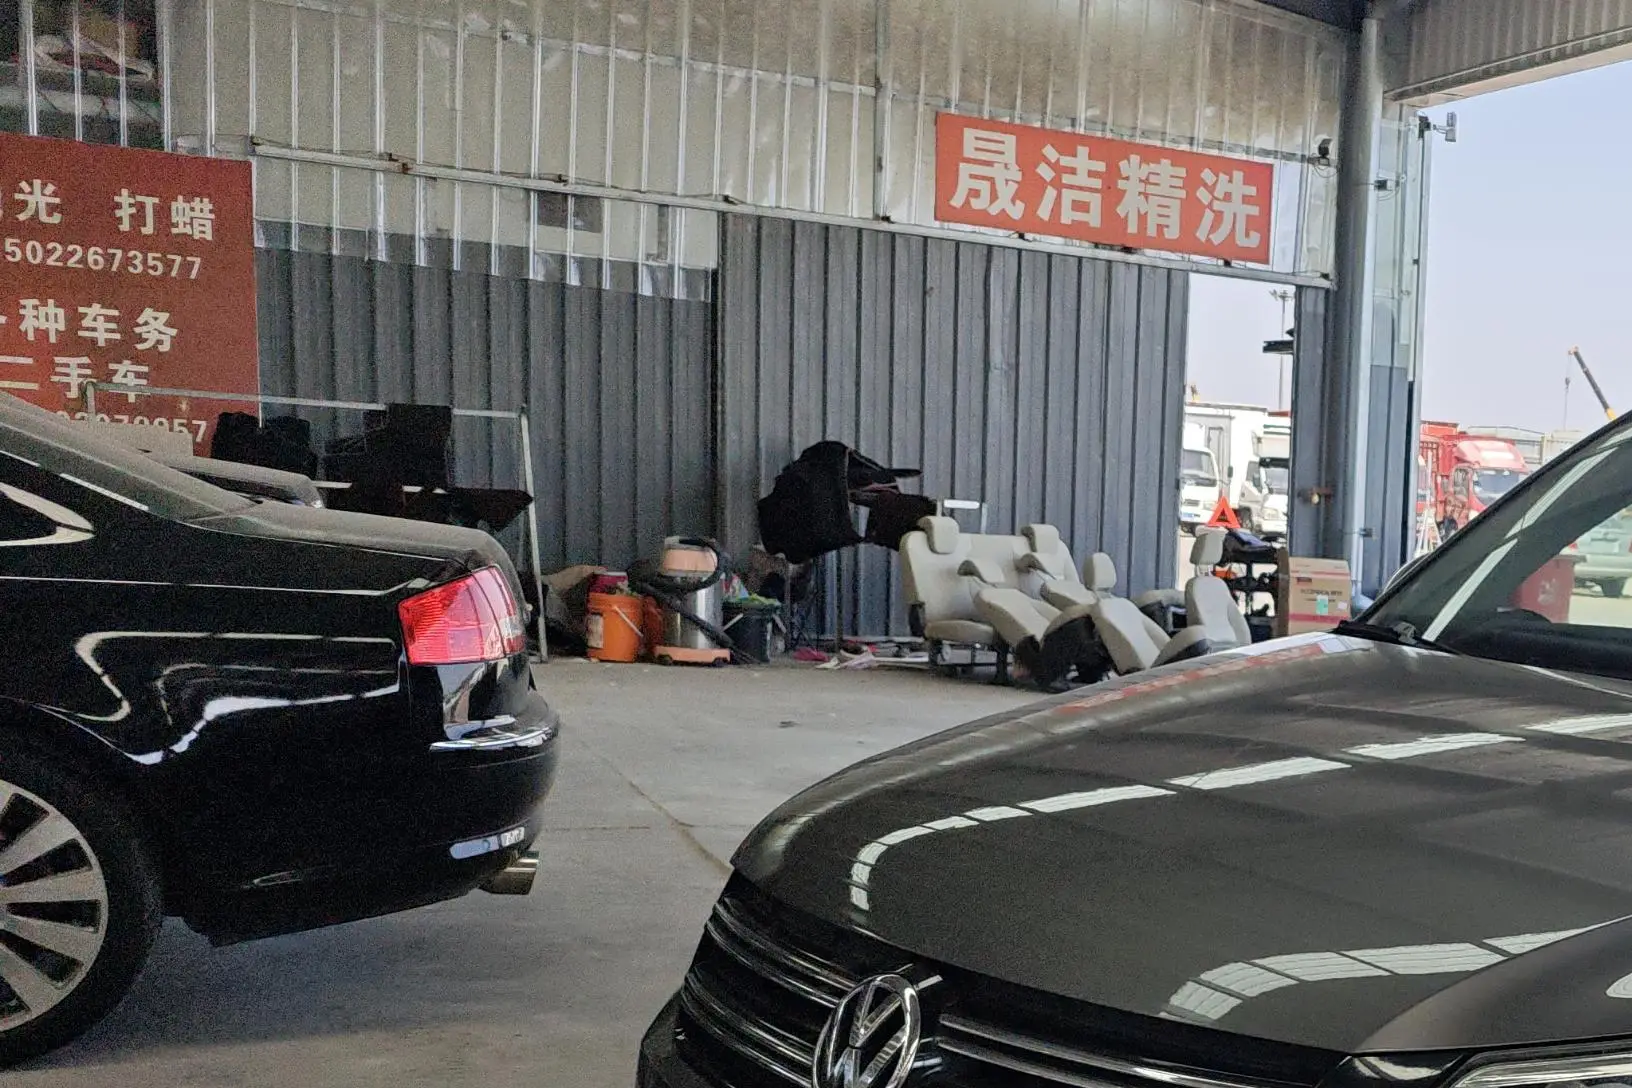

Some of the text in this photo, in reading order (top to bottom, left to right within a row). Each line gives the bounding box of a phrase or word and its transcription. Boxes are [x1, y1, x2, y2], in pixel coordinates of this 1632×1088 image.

[0, 179, 215, 240] 光 打蜡
[950, 127, 1261, 248] 晟洁精洗
[4, 237, 201, 279] 5022673577
[0, 299, 178, 352] 种车务
